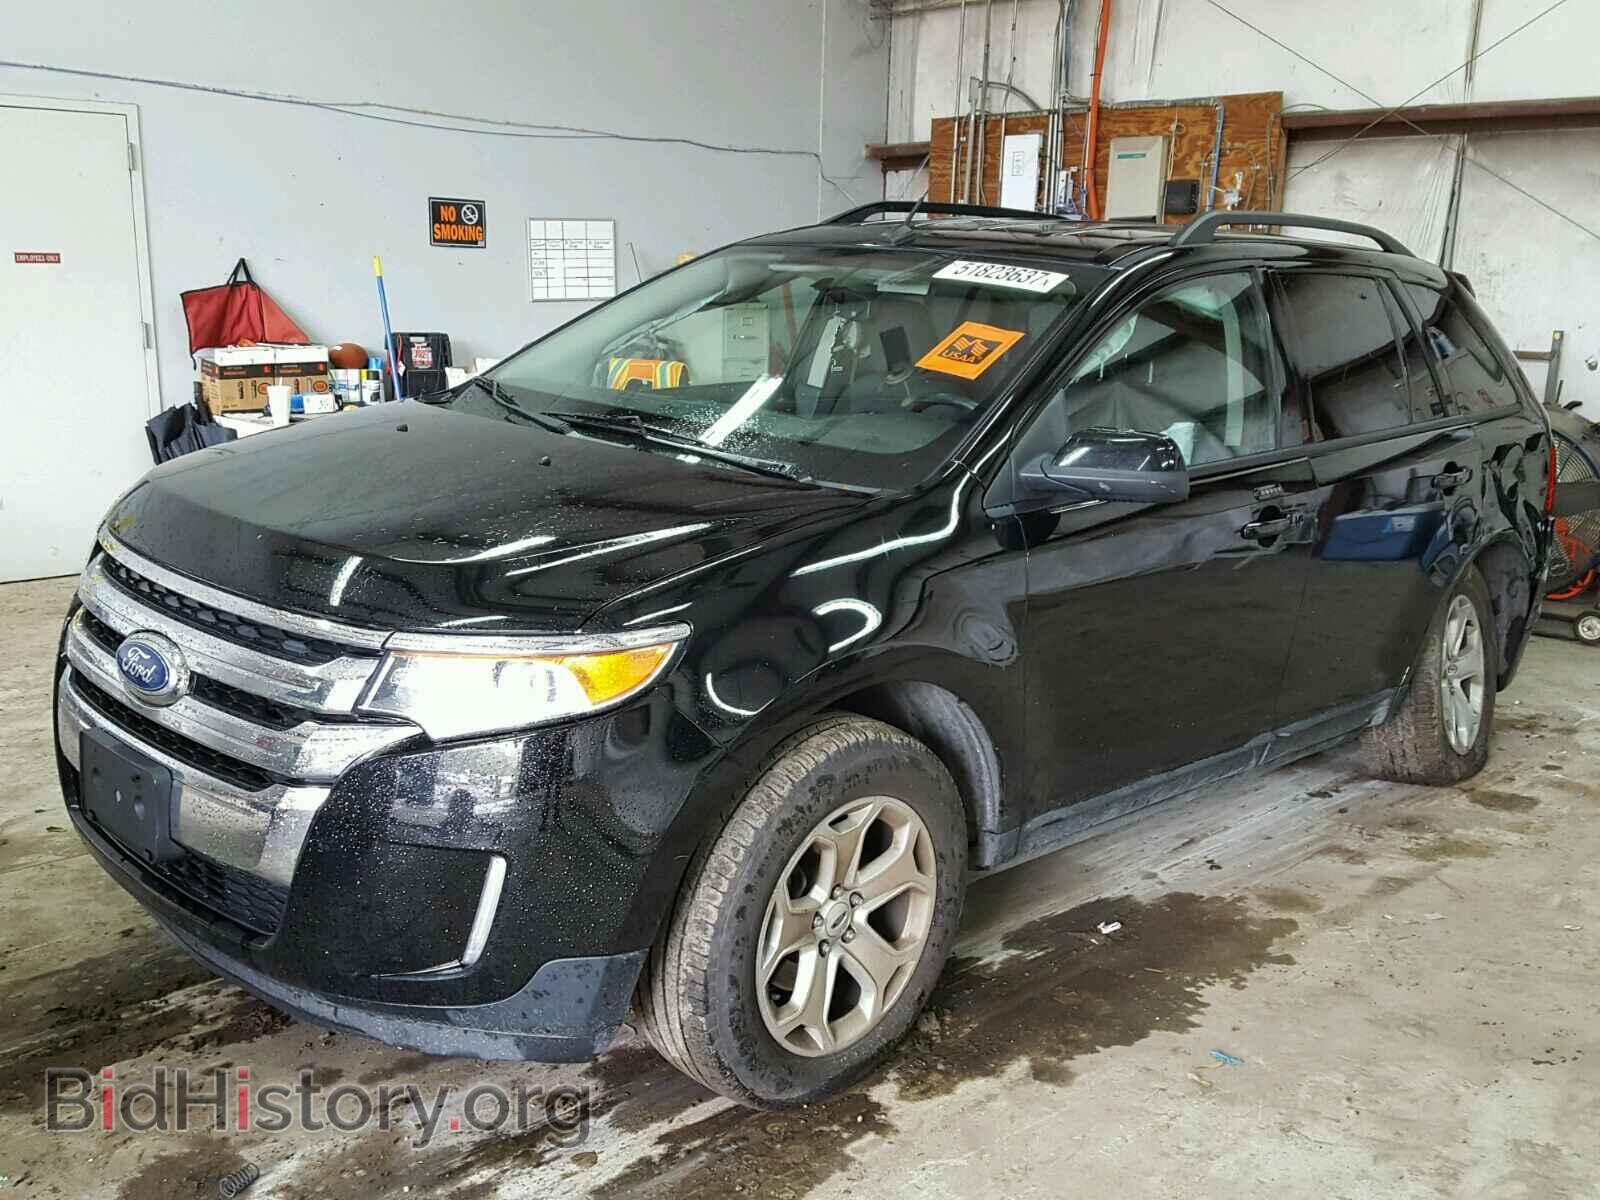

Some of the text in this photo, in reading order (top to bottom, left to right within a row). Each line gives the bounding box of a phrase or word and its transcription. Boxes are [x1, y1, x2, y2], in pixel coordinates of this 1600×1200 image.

[440, 205, 457, 222] NO
[433, 223, 483, 241] SMOKING
[942, 349, 976, 363] USAA
[122, 646, 157, 683] Ford
